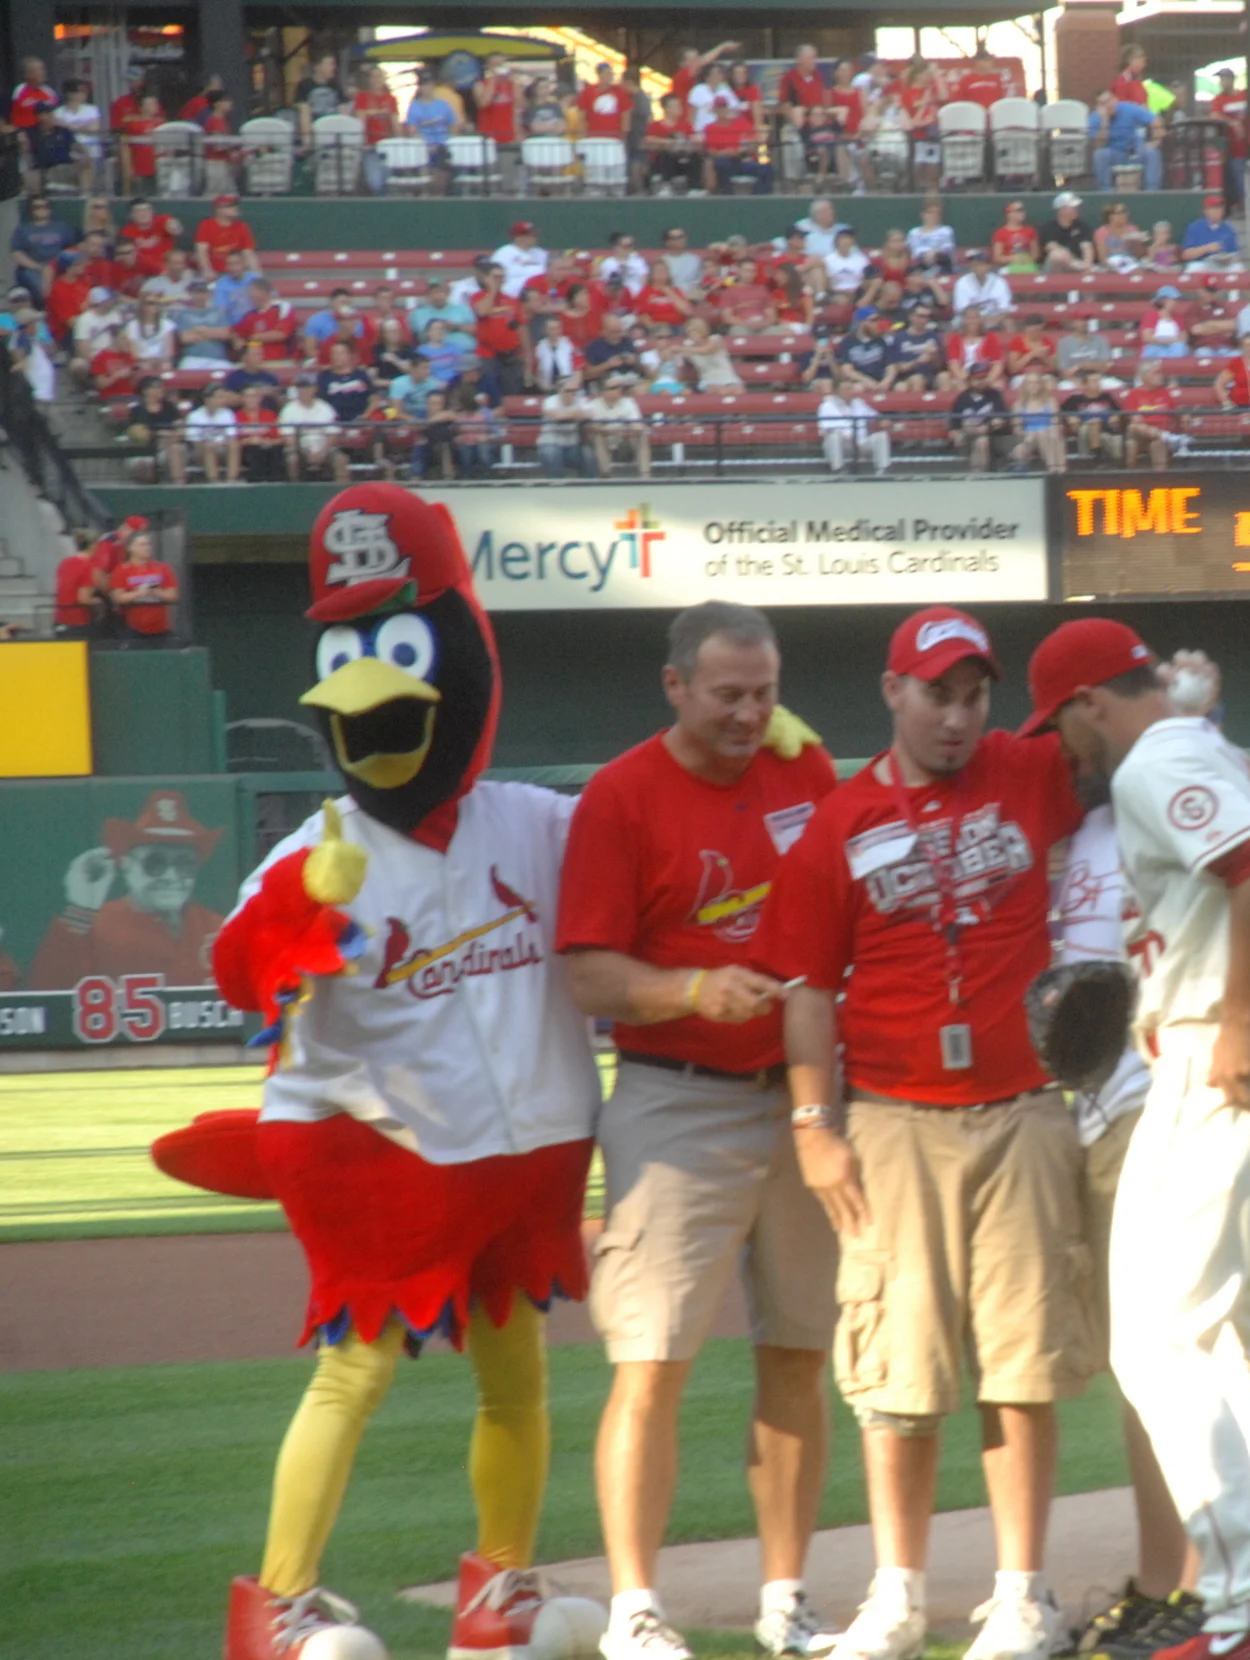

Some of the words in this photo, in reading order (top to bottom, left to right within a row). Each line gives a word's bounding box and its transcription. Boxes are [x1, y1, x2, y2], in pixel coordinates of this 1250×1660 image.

[703, 520, 797, 544] Official
[805, 518, 904, 543] Medical
[912, 516, 1020, 541] Provider
[1066, 487, 1202, 538] TIME
[471, 529, 620, 593] Mercy
[704, 554, 727, 577] of
[735, 552, 773, 577] the
[781, 551, 809, 576] St.
[818, 551, 880, 575] Louis
[887, 548, 999, 574] Cardinals
[866, 821, 1034, 913] OCTBER
[407, 931, 543, 1000] Cardinals
[73, 974, 167, 1044] 85
